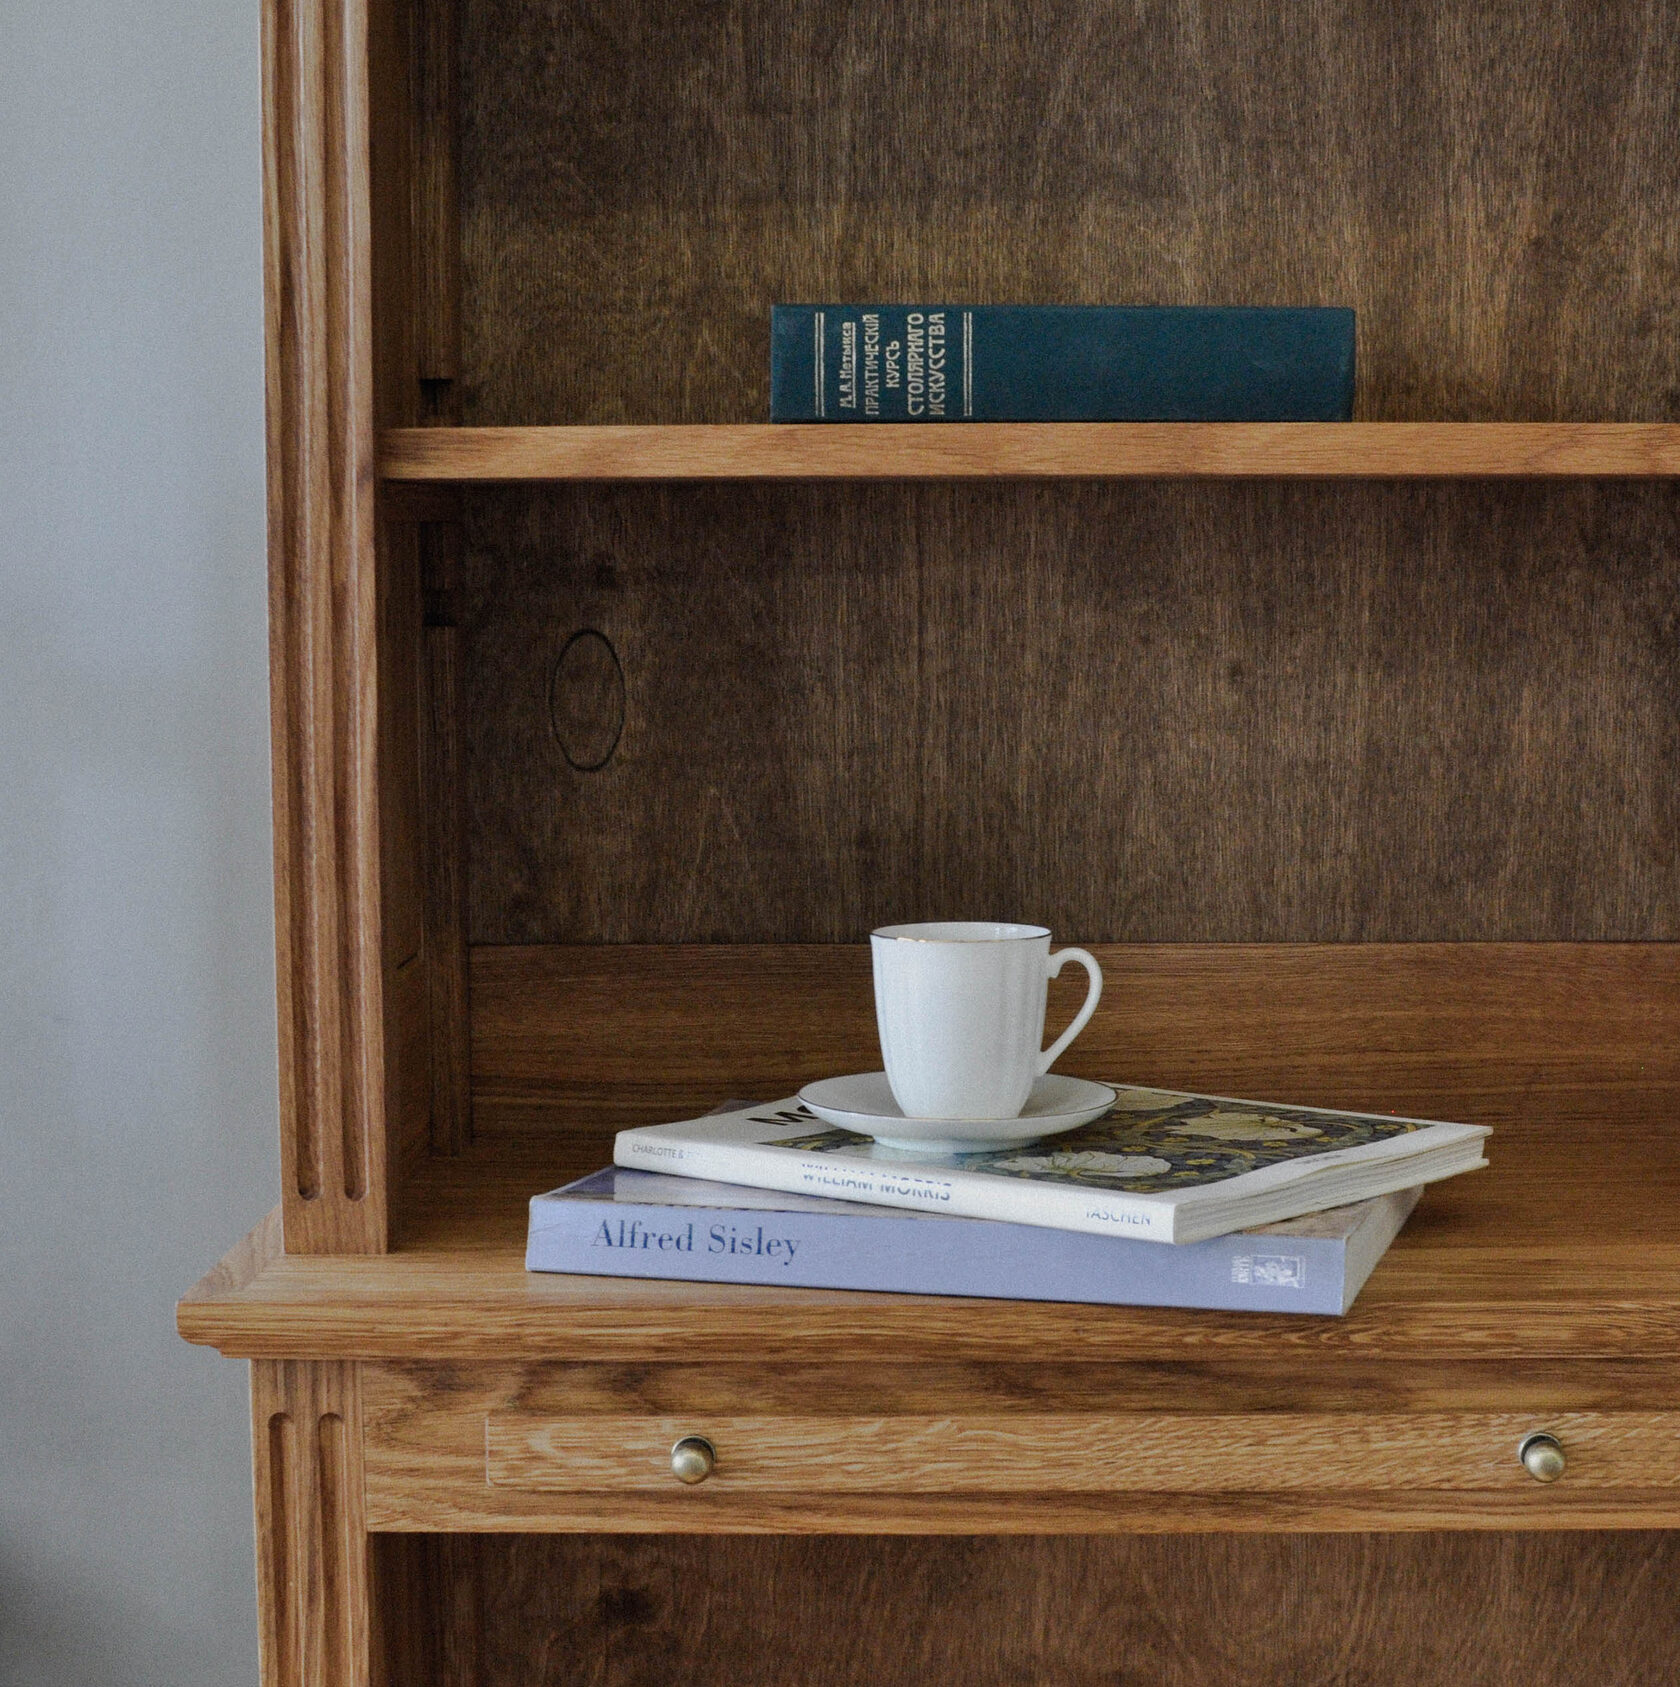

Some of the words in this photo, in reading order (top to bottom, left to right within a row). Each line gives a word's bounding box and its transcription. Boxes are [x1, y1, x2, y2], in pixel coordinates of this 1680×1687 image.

[885, 340, 900, 388] КУРСЪ
[907, 312, 925, 416] СТОЛЯРНАГО
[928, 312, 946, 416] ИСКУССТВА
[632, 1143, 677, 1159] CHARLOTTE
[591, 1218, 694, 1252] Alfred
[707, 1223, 801, 1266] Sisley
